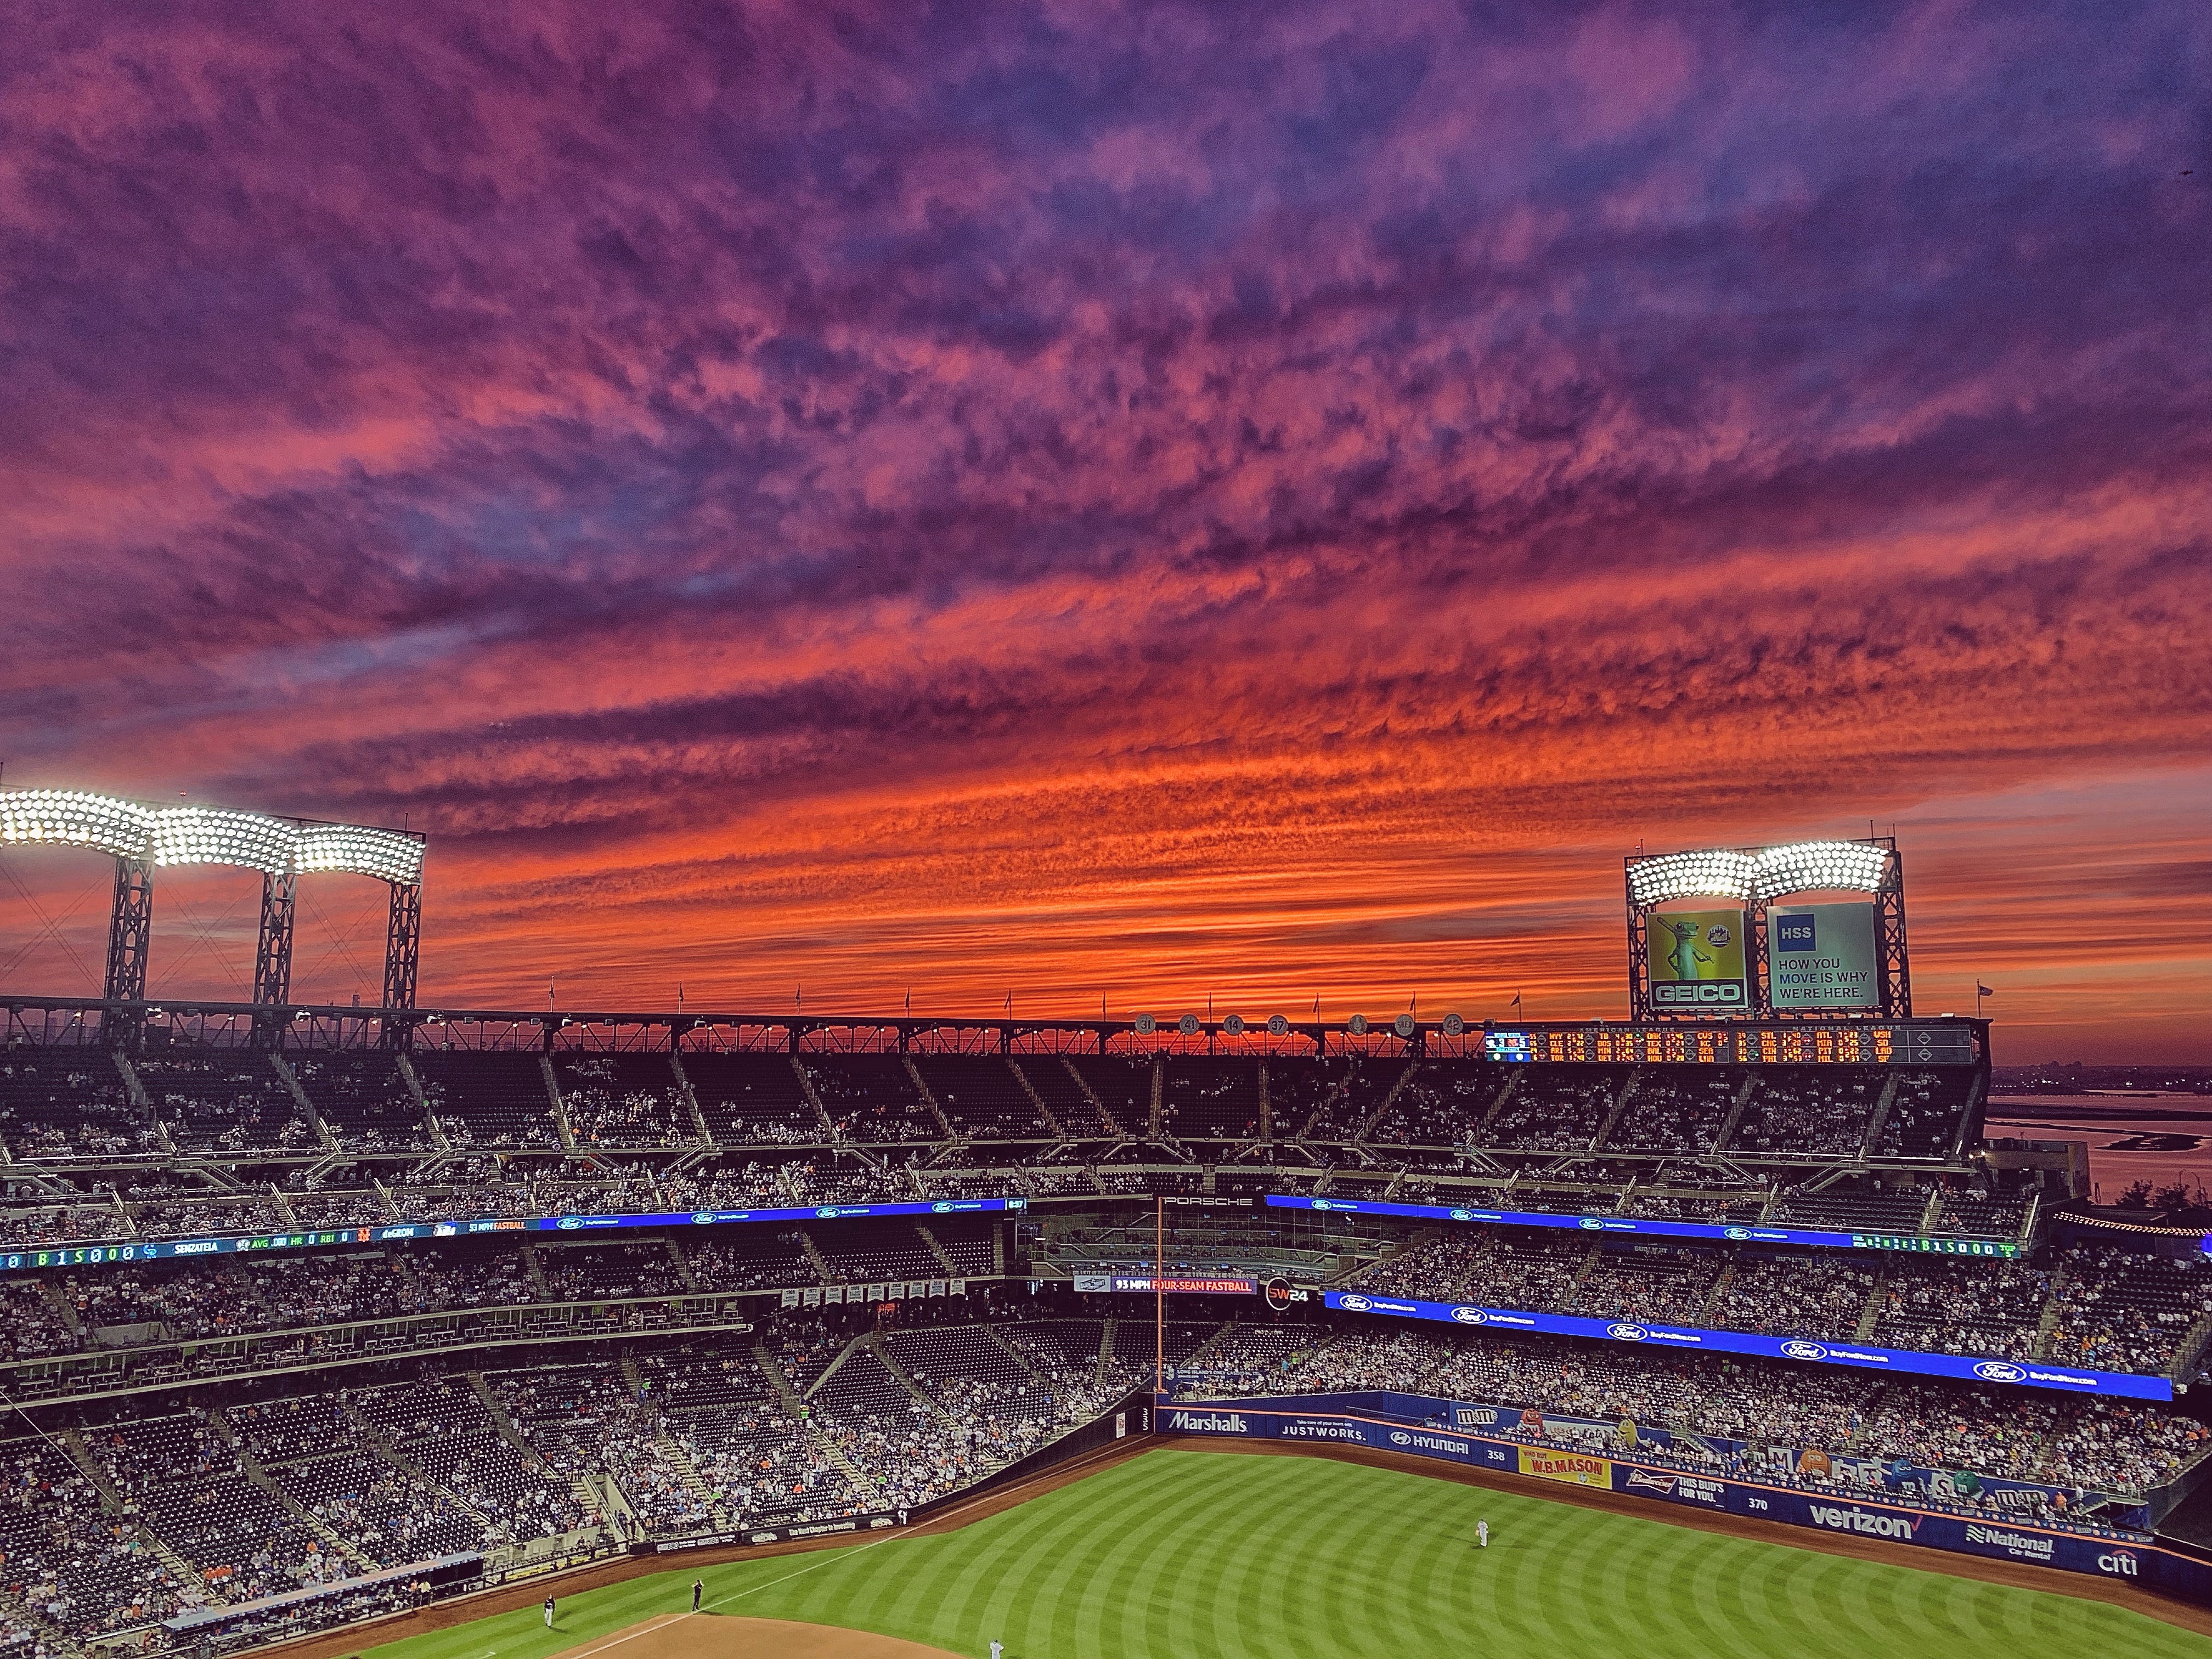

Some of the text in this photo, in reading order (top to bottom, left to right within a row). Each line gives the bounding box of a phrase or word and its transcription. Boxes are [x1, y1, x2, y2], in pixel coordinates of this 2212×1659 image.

[1781, 927, 1812, 939] HSS
[1779, 958, 1840, 970] HOW YOU
[1780, 972, 1869, 984] MOVE IS WHY
[1656, 984, 1741, 1002] GEICO
[1780, 987, 1863, 999] WE'RE HERE.
[1141, 1020, 1151, 1030] 31
[1184, 1020, 1195, 1030] 41
[1228, 1020, 1238, 1030] 14
[1271, 1020, 1284, 1030] 37
[1446, 1020, 1459, 1030] 42
[1519, 1038, 1525, 1047] 5
[1164, 1197, 1253, 1206] PORSCHE
[478, 1222, 526, 1231] MPH FASTBALL
[291, 1237, 302, 1245] HR
[309, 1235, 315, 1244] 0
[320, 1234, 334, 1243] RBI
[342, 1232, 348, 1242] 0
[382, 1228, 414, 1238] deGROM
[174, 1243, 218, 1254] SENZATELA
[1922, 1240, 1929, 1251] B
[1934, 1242, 1942, 1251] 1
[1948, 1242, 1955, 1252] S
[1959, 1243, 1967, 1252] 0
[1985, 1245, 1993, 1255] 0
[8, 1247, 133, 1268] 0 B 1 S 0 0
[1116, 1279, 1128, 1289] 93
[1130, 1280, 1151, 1289] MPH
[1206, 1282, 1252, 1291] FASTBALL
[1269, 1288, 1308, 1302] SW24
[1345, 1296, 1368, 1310] Ford
[1458, 1309, 1481, 1322] Ford
[1614, 1325, 1641, 1339] Ford
[1788, 1343, 1819, 1358] Ford
[1982, 1364, 2097, 1385] Ford BuyFordNow.com
[1169, 1412, 1248, 1432] Marshalls
[1282, 1426, 1367, 1441] JUSTWORKS.
[1413, 1436, 1469, 1454] HYUNDAI
[1488, 1450, 1505, 1461] 358
[1679, 1477, 1724, 1493] THIS BUD'S
[1679, 1487, 1716, 1503] FOR YOU.
[1749, 1498, 1768, 1510] 370
[1810, 1505, 1912, 1539] verizon
[1985, 1530, 2054, 1552] National
[2025, 1550, 2051, 1560] Rental
[2098, 1554, 2137, 1575] citi
